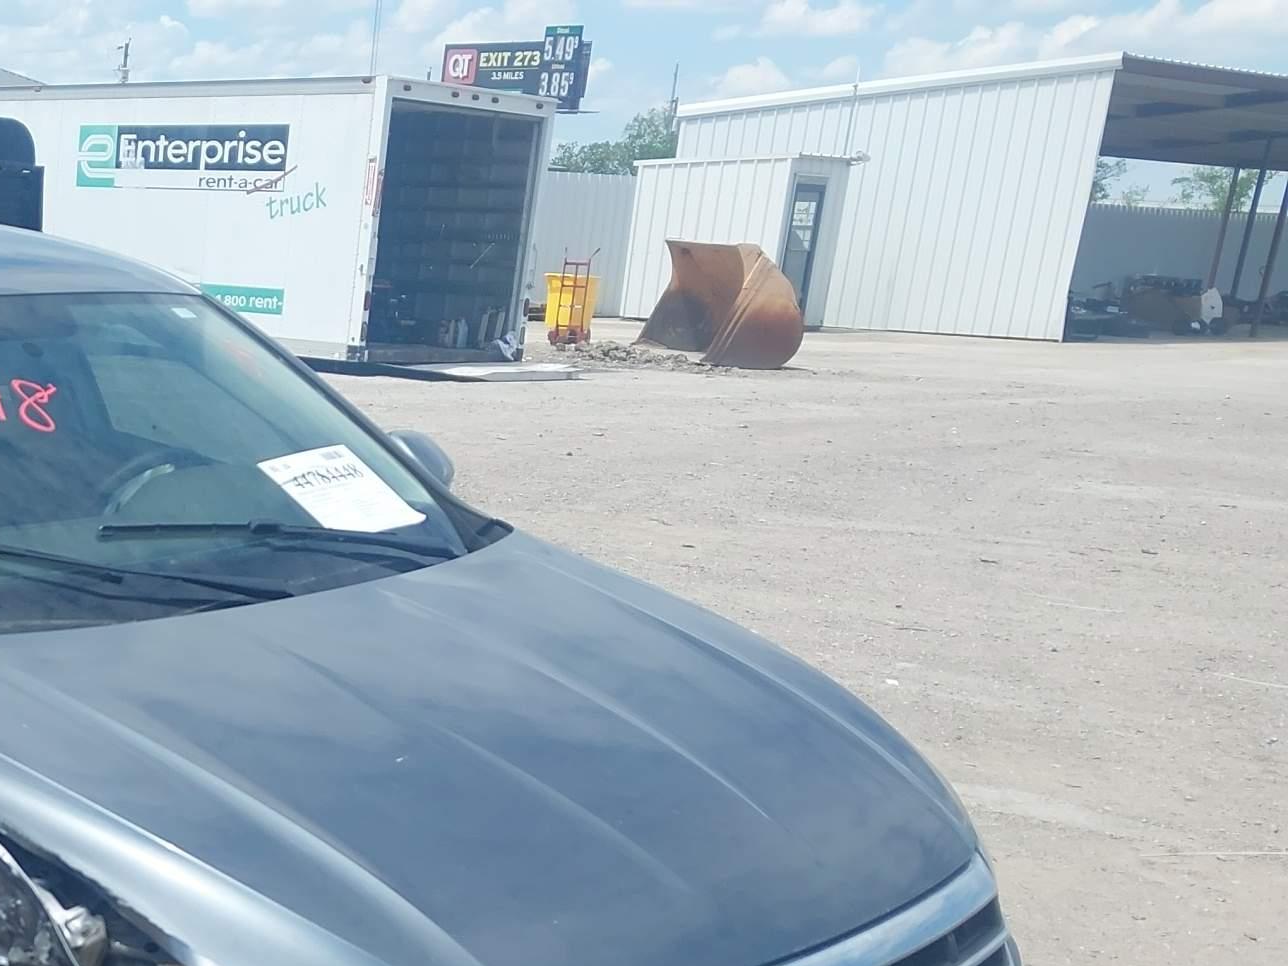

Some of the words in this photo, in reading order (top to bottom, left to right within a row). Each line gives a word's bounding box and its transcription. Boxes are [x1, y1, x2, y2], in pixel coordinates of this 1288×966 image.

[448, 53, 473, 79] QT
[479, 52, 512, 67] EXIT
[513, 50, 541, 67] 273
[503, 71, 525, 80] MILES
[119, 130, 285, 171] Enterprise
[198, 173, 284, 190] rent-a-car
[265, 181, 327, 220] truck
[223, 294, 247, 307] 800
